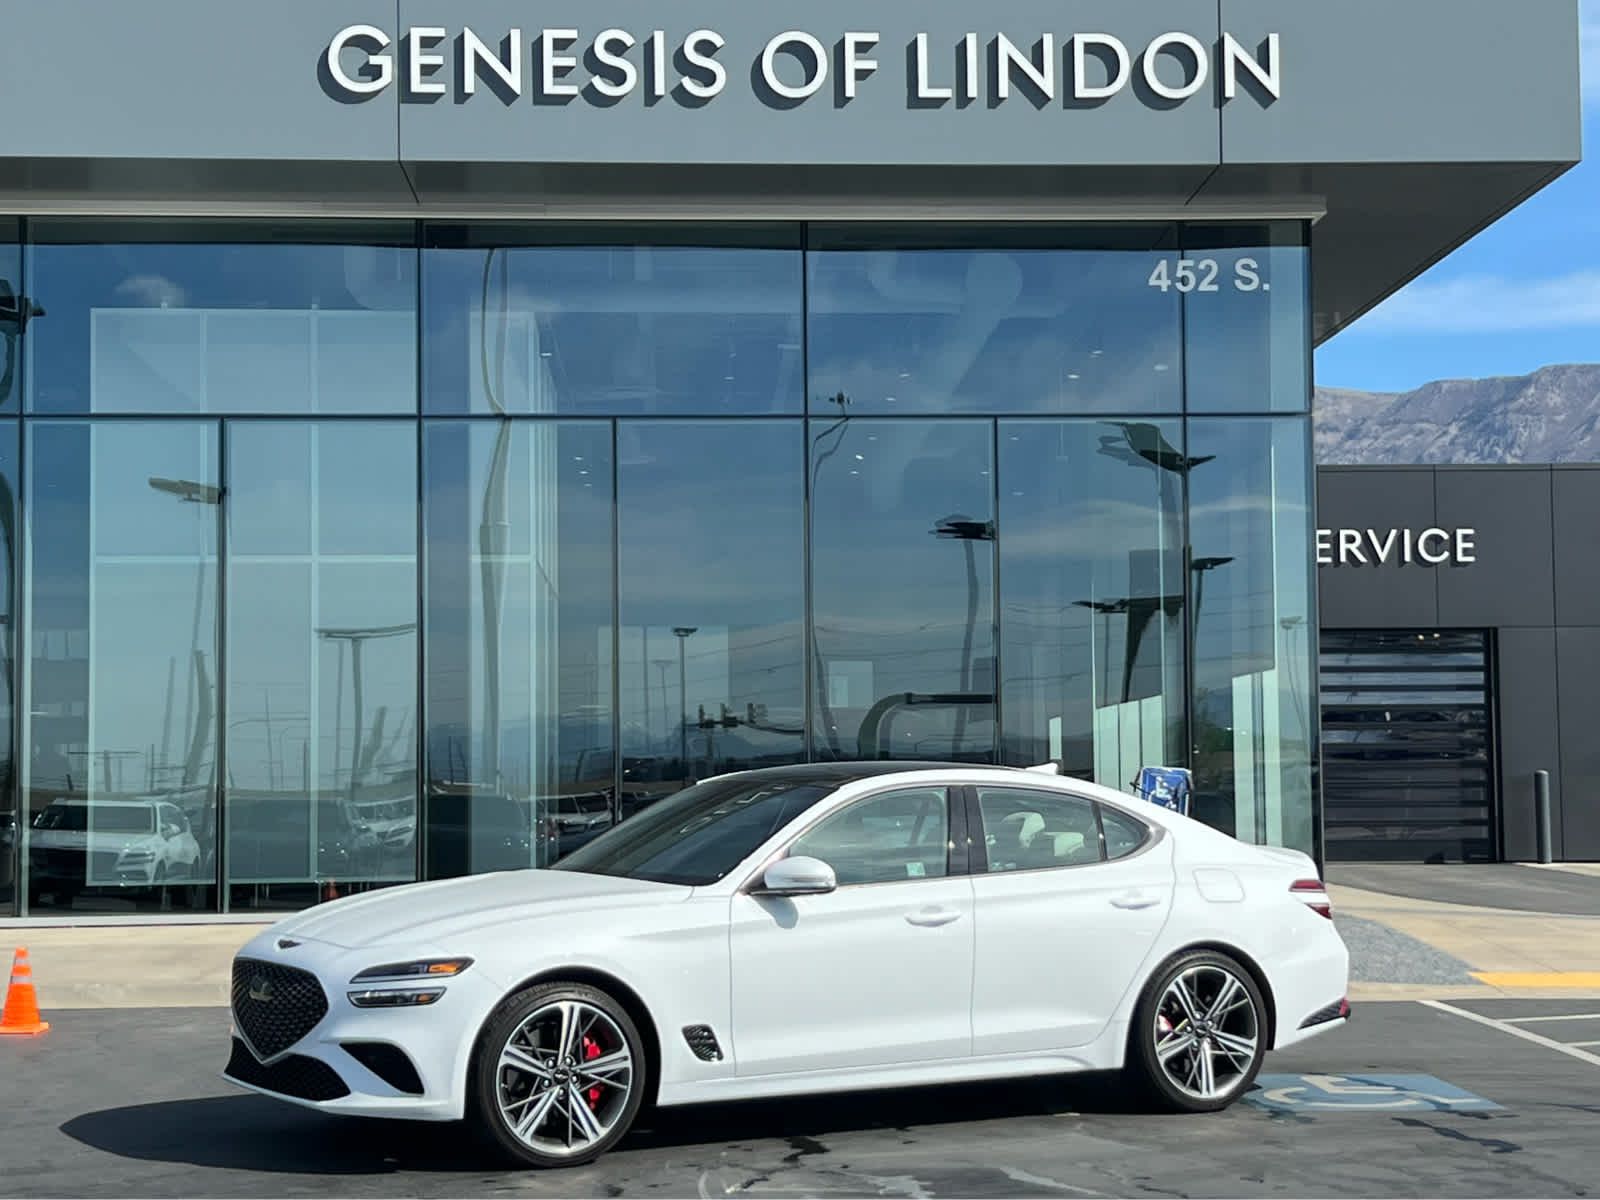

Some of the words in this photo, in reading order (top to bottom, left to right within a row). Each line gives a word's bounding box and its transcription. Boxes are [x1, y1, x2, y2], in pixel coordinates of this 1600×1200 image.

[327, 25, 726, 97] GENESIS
[762, 31, 879, 98] OF
[917, 32, 1280, 99] LINDON
[1148, 258, 1218, 292] 452
[1234, 257, 1270, 291] S.
[1316, 528, 1475, 563] ERVICE
